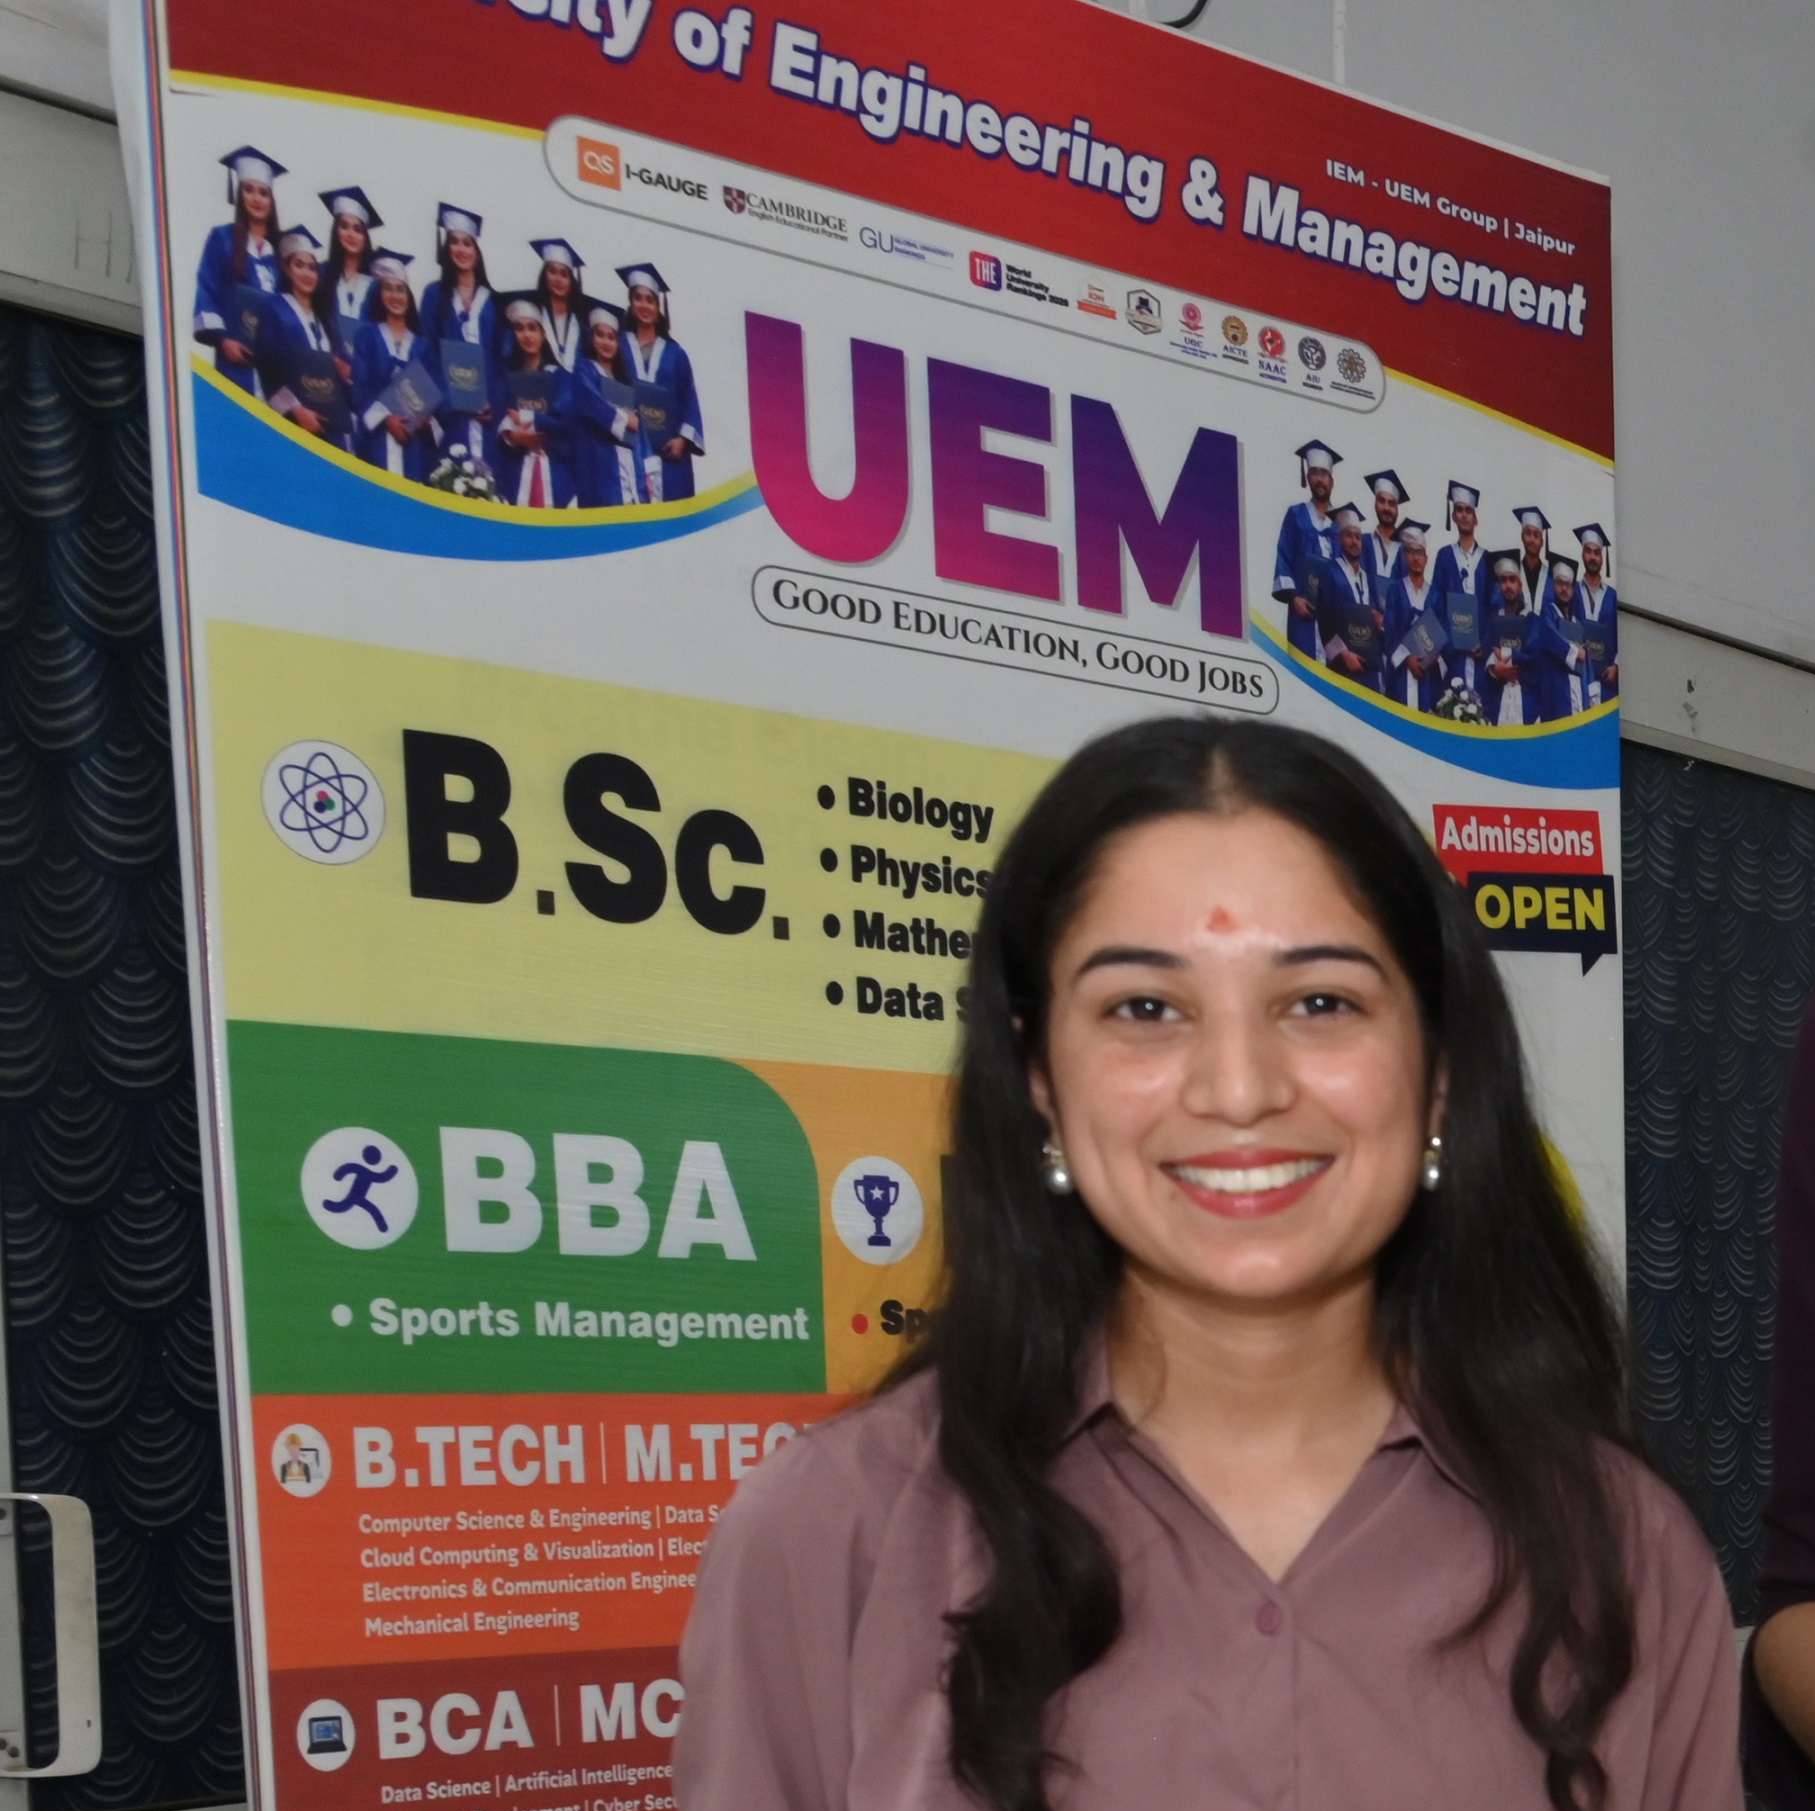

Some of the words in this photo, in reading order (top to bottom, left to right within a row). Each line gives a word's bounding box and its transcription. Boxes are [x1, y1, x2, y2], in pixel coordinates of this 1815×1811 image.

[583, 151, 615, 175] QS
[625, 163, 708, 201] I-GAUGE
[673, 8, 753, 77] of
[771, 21, 1163, 217] Engineering
[1184, 158, 1224, 224] &
[1242, 177, 1587, 336] Management
[746, 192, 848, 233] CAMBRIDGE
[1327, 159, 1365, 187] IEM
[1385, 178, 1430, 208] UEM
[1437, 197, 1498, 232] Group
[1515, 222, 1575, 256] Jaipur
[859, 226, 894, 253] GU
[975, 257, 997, 285] THE
[1006, 264, 1032, 279] World
[1006, 273, 1049, 293] University
[1006, 282, 1047, 302] Rankings
[1222, 343, 1248, 358] AICTE
[1258, 359, 1287, 376] NAAC
[745, 310, 1243, 640] UEM
[772, 579, 882, 624] GOOD
[893, 600, 1087, 668] EDUCATION,
[1096, 641, 1191, 683] GOOD
[1198, 660, 1264, 699] JOBS
[848, 777, 994, 844] Biology
[403, 728, 790, 941] B.Sc.
[1441, 814, 1595, 857] Admissions
[1475, 884, 1606, 931] OPEN
[854, 910, 977, 960] Mathe
[856, 976, 944, 1021] Data
[439, 1126, 758, 1262] BBA
[369, 1298, 520, 1345] Sports
[535, 1301, 810, 1348] Management
[353, 1423, 586, 1488] B.TECH
[624, 1421, 816, 1483] M.TE
[358, 1513, 450, 1537] Computer
[456, 1509, 525, 1531] Science
[530, 1509, 544, 1528] &
[549, 1505, 652, 1532] Engineering
[664, 1505, 704, 1525] Data
[360, 1547, 415, 1570] Cloud
[420, 1543, 519, 1571] Computing
[523, 1543, 538, 1562] &
[543, 1538, 654, 1562] Visualization
[362, 1580, 467, 1603] Electronics
[472, 1578, 487, 1598] &
[492, 1573, 627, 1597] Communication
[631, 1569, 698, 1596] Enginee
[365, 1612, 470, 1637] Mechanical
[474, 1606, 580, 1635] Engineering
[376, 1689, 534, 1760] BCA
[579, 1678, 685, 1744] MC
[381, 1784, 423, 1805] Data
[426, 1779, 492, 1801] Science
[505, 1769, 578, 1793] Artificial
[581, 1761, 673, 1788] Intelligence
